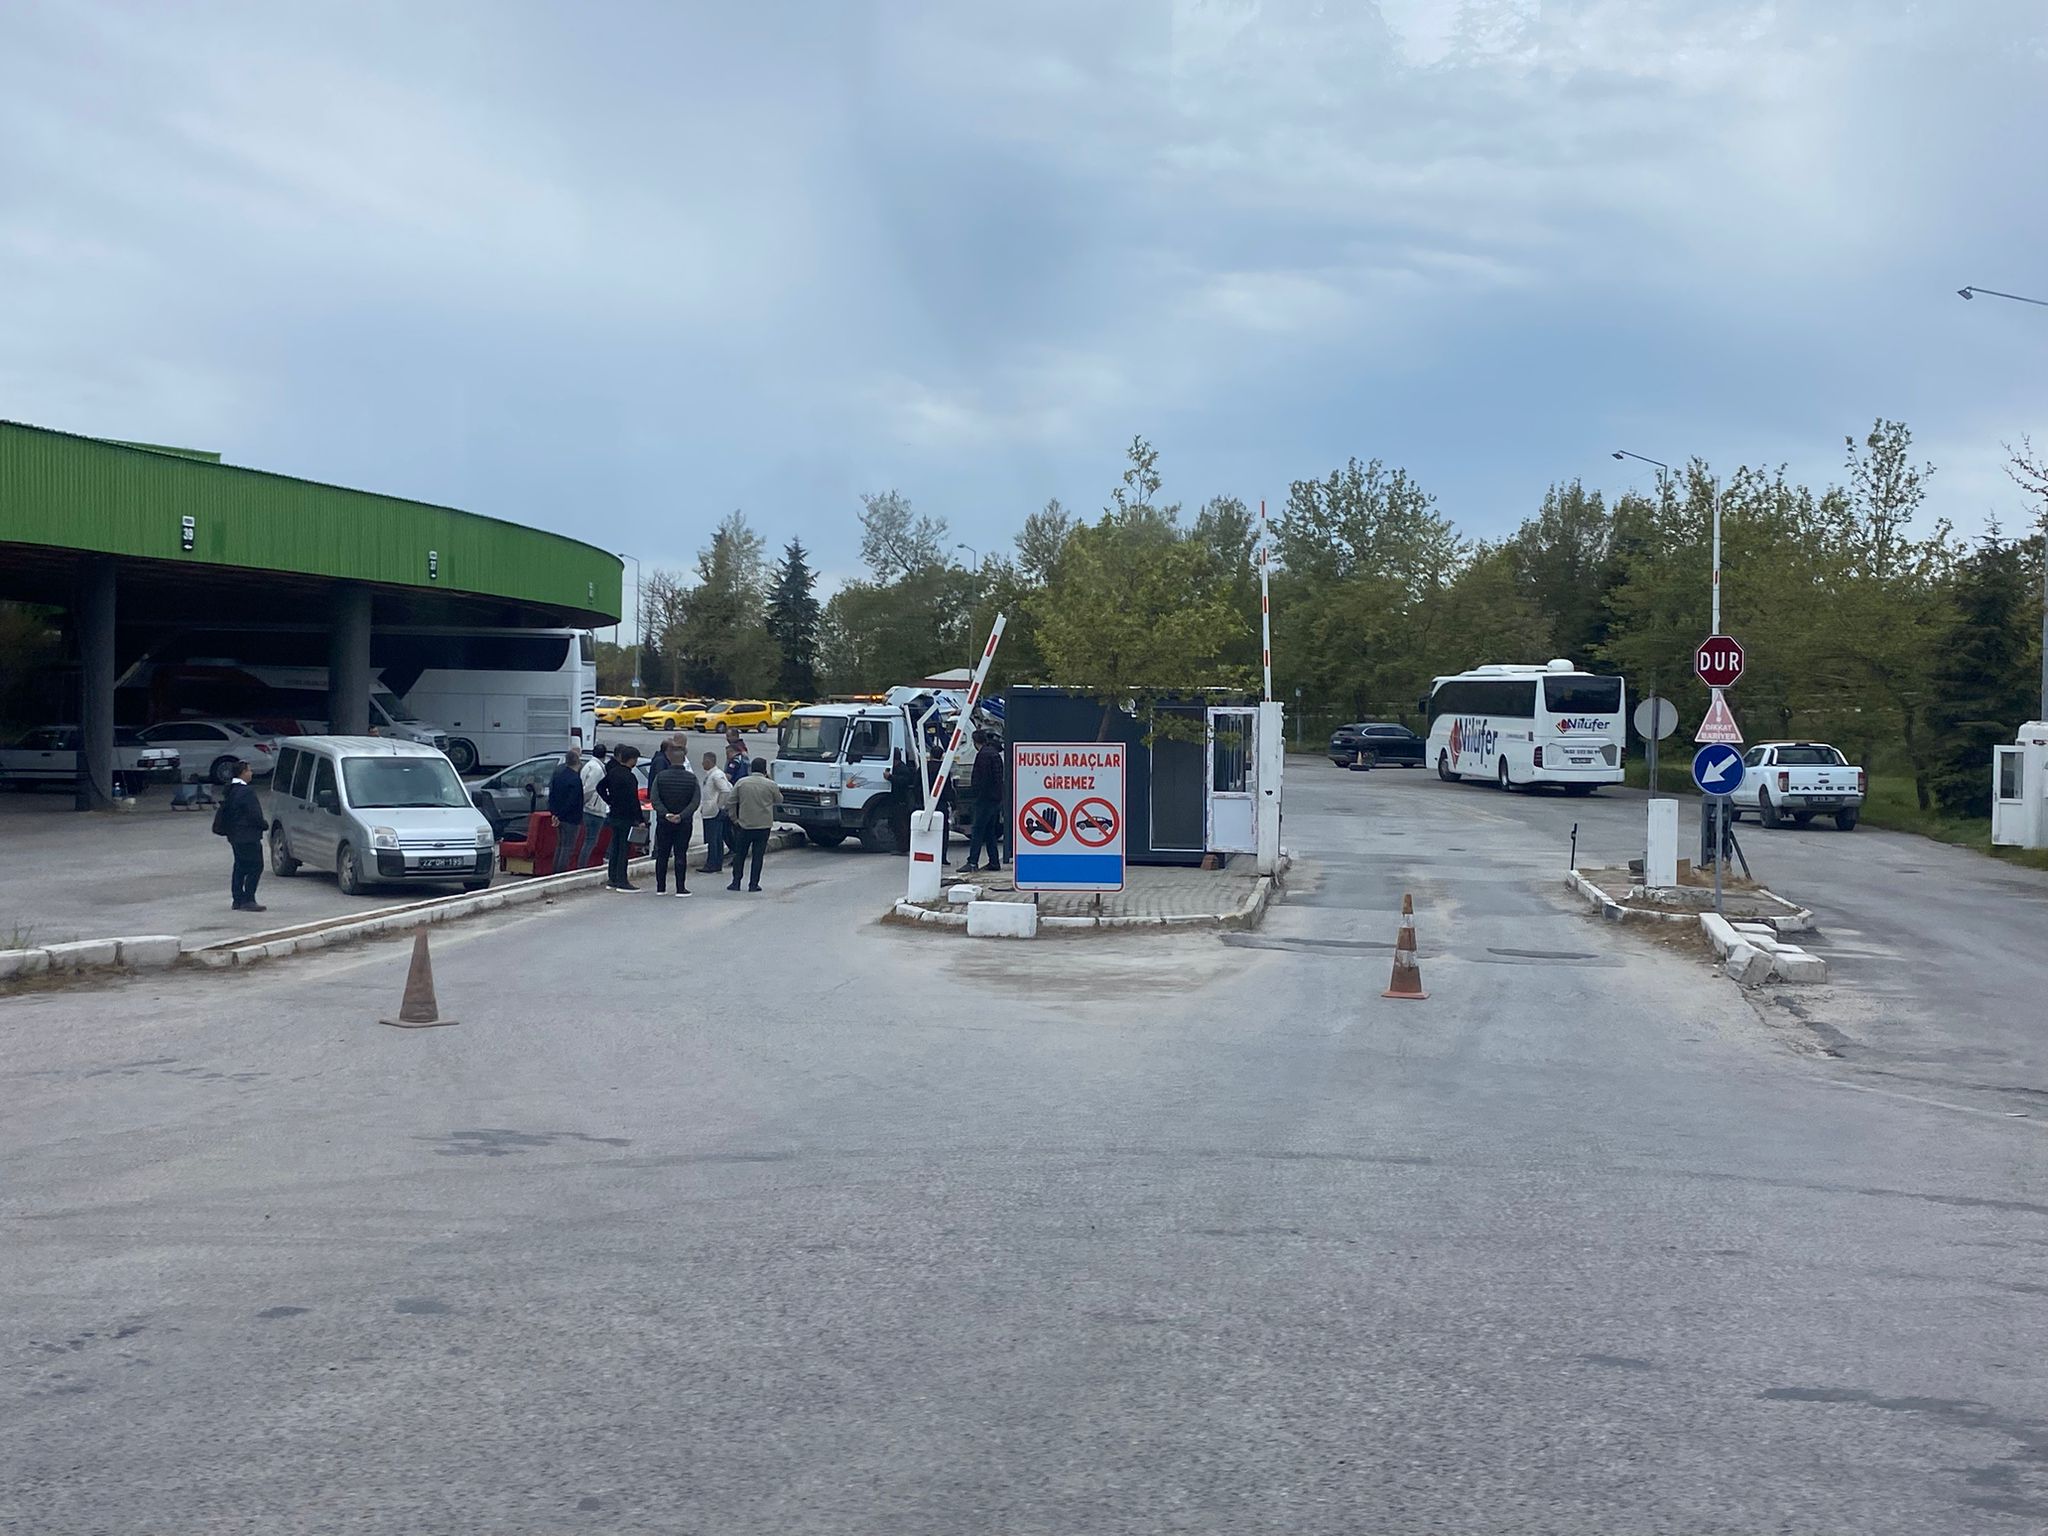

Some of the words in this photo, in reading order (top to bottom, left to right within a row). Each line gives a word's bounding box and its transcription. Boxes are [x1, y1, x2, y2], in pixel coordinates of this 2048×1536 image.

[1700, 652, 1740, 671] DUR
[1567, 717, 1610, 732] Nilüfer
[1459, 717, 1498, 764] Nilüfer
[1018, 750, 1059, 767] HUSUSİ
[1063, 753, 1120, 771] ARAÇLAR
[1043, 773, 1095, 790] GİREMEZ
